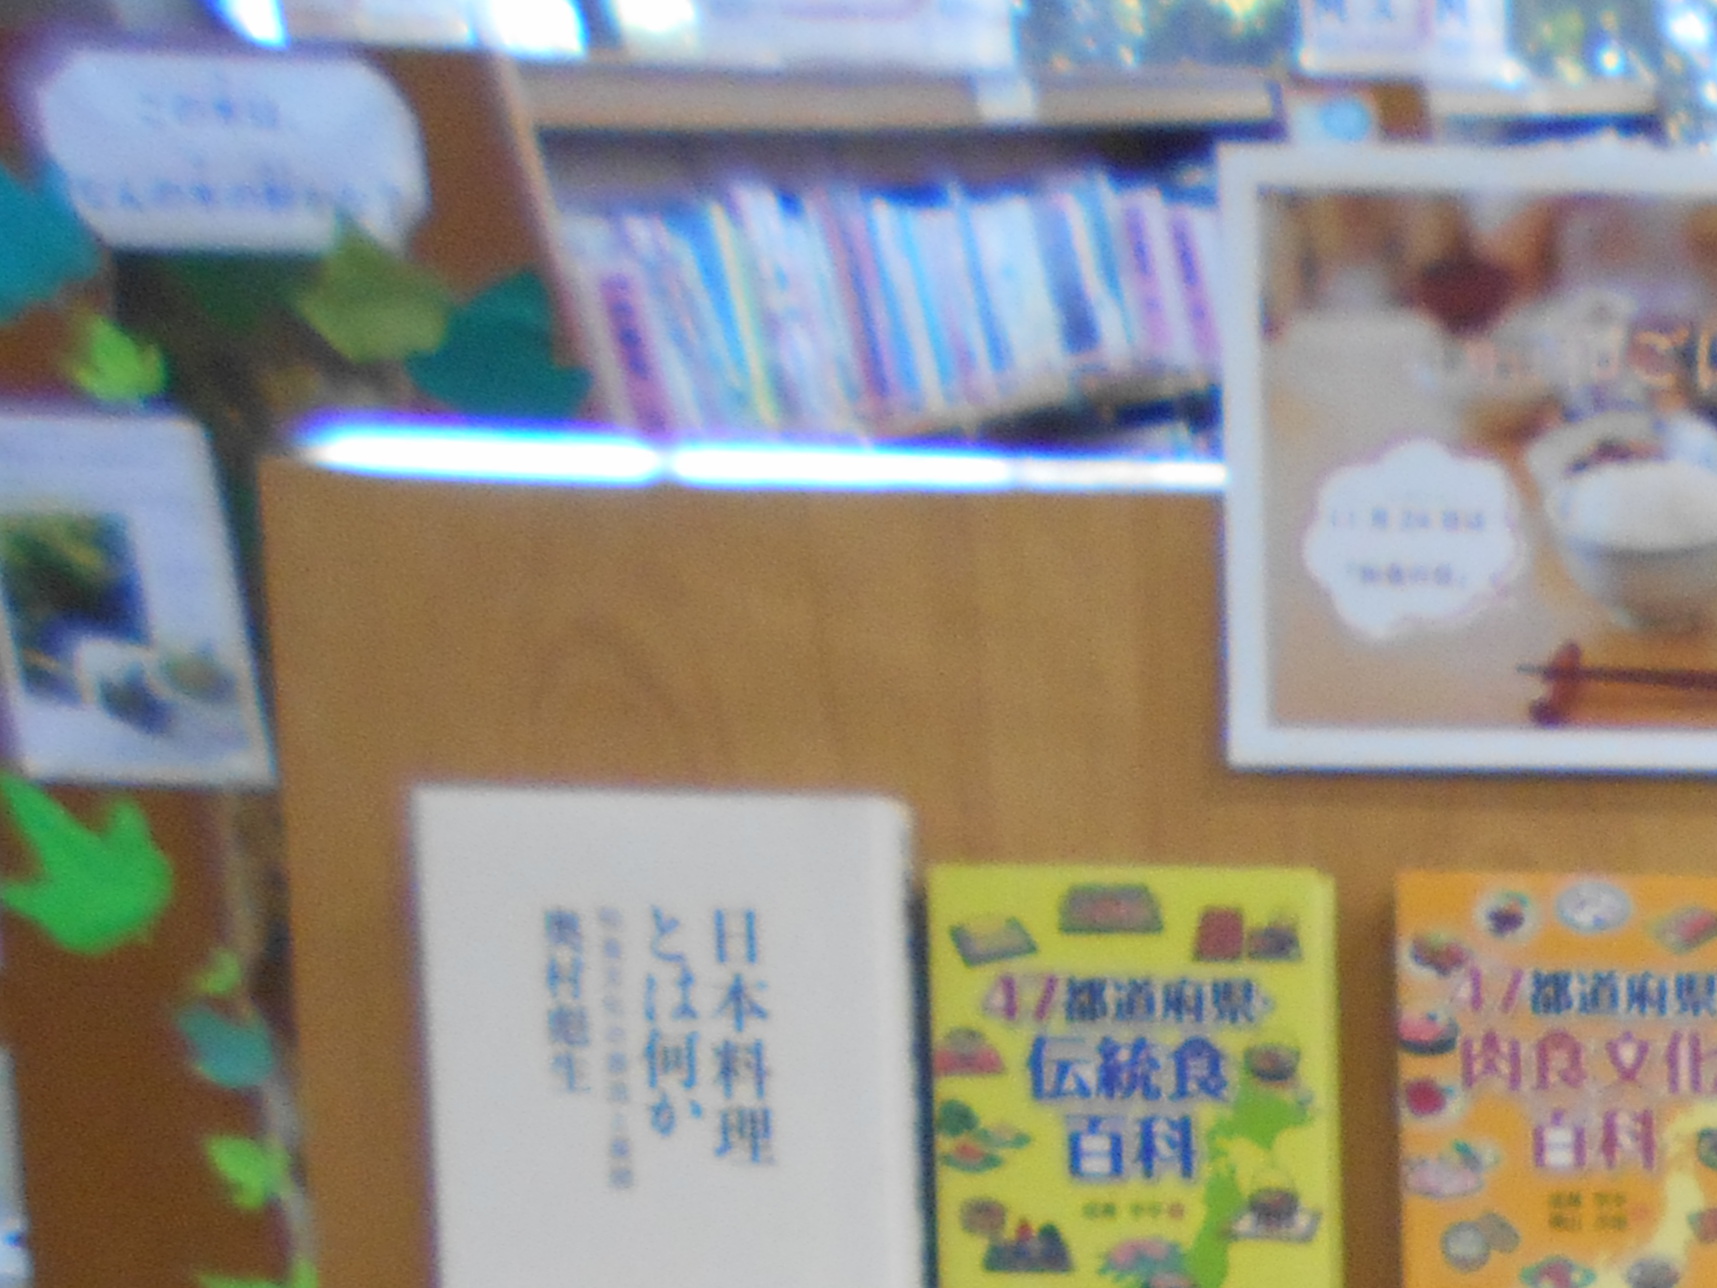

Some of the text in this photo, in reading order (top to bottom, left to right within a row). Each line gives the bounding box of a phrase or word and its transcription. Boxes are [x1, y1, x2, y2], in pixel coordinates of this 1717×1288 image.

[643, 904, 704, 1138] とは何か
[711, 905, 778, 1168] 日本料理
[1029, 1034, 1228, 1100] 伝統食
[1066, 1113, 1194, 1180] 百科
[1532, 1108, 1656, 1170] 百科
